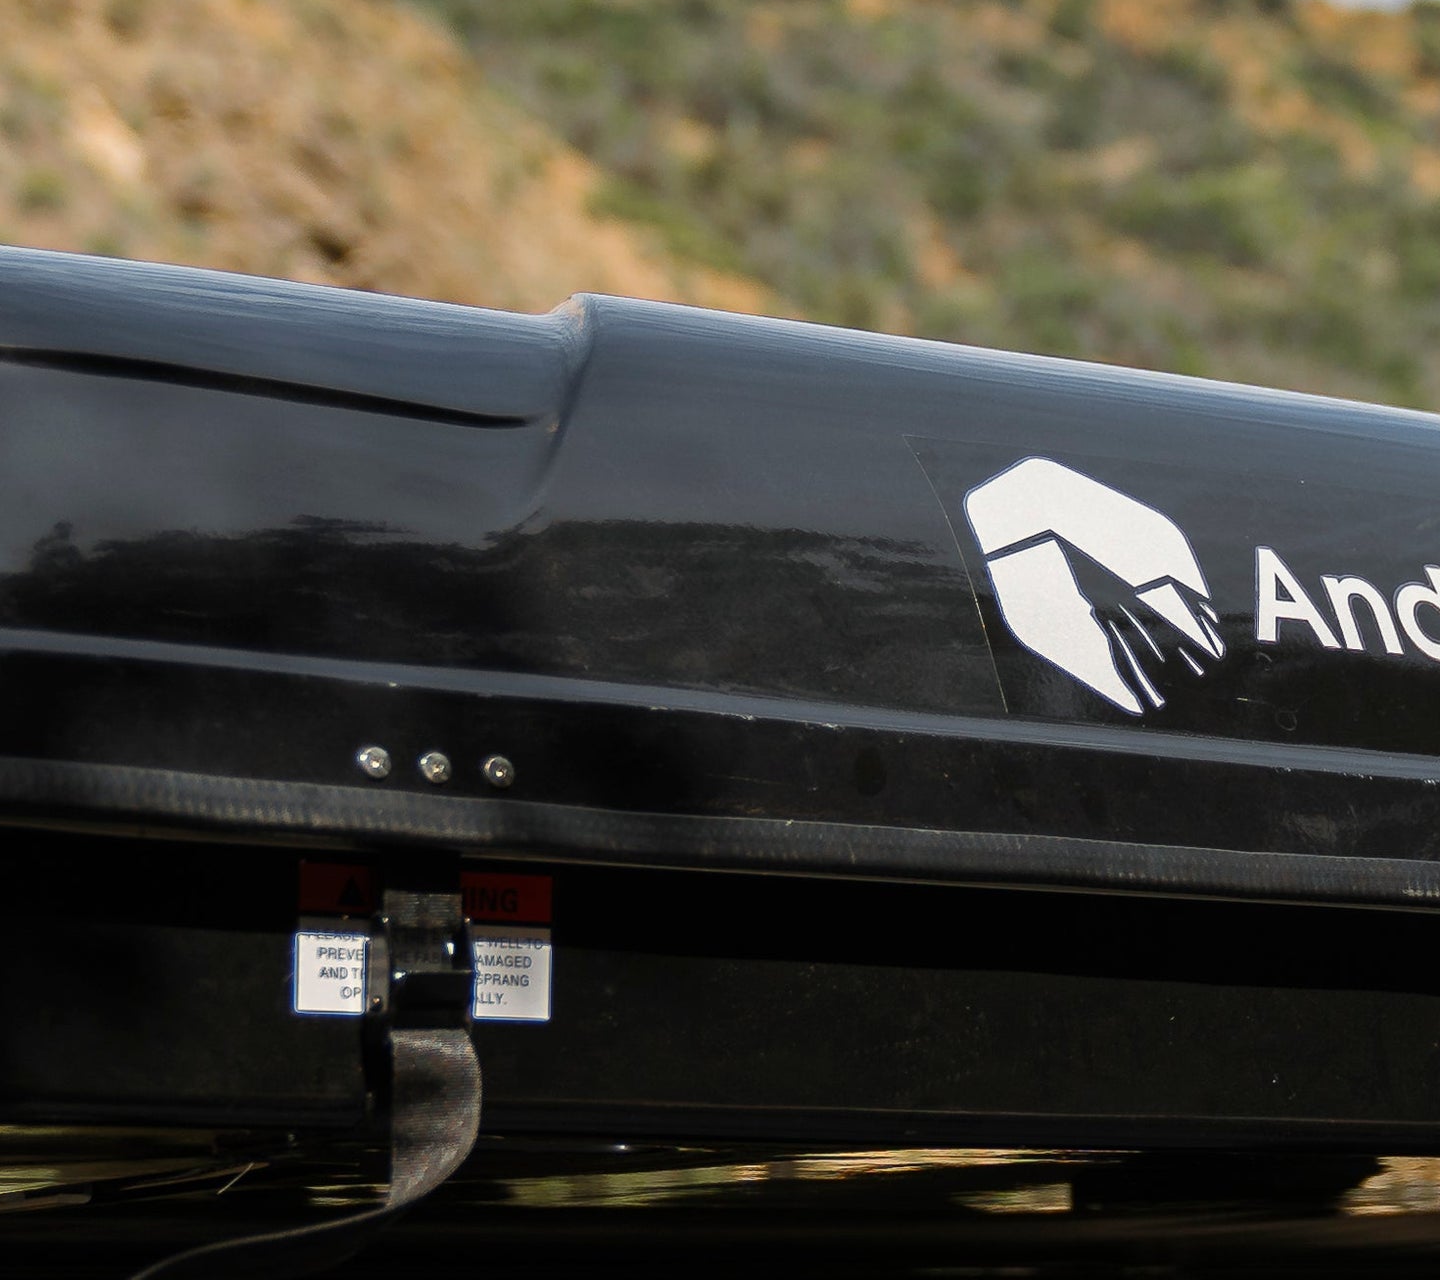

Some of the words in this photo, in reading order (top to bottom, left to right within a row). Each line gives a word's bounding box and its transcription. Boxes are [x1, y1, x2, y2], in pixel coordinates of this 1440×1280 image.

[317, 946, 363, 961] PREVE
[476, 955, 532, 969] AMAGED
[319, 966, 348, 980] AND
[340, 985, 362, 1000] OP
